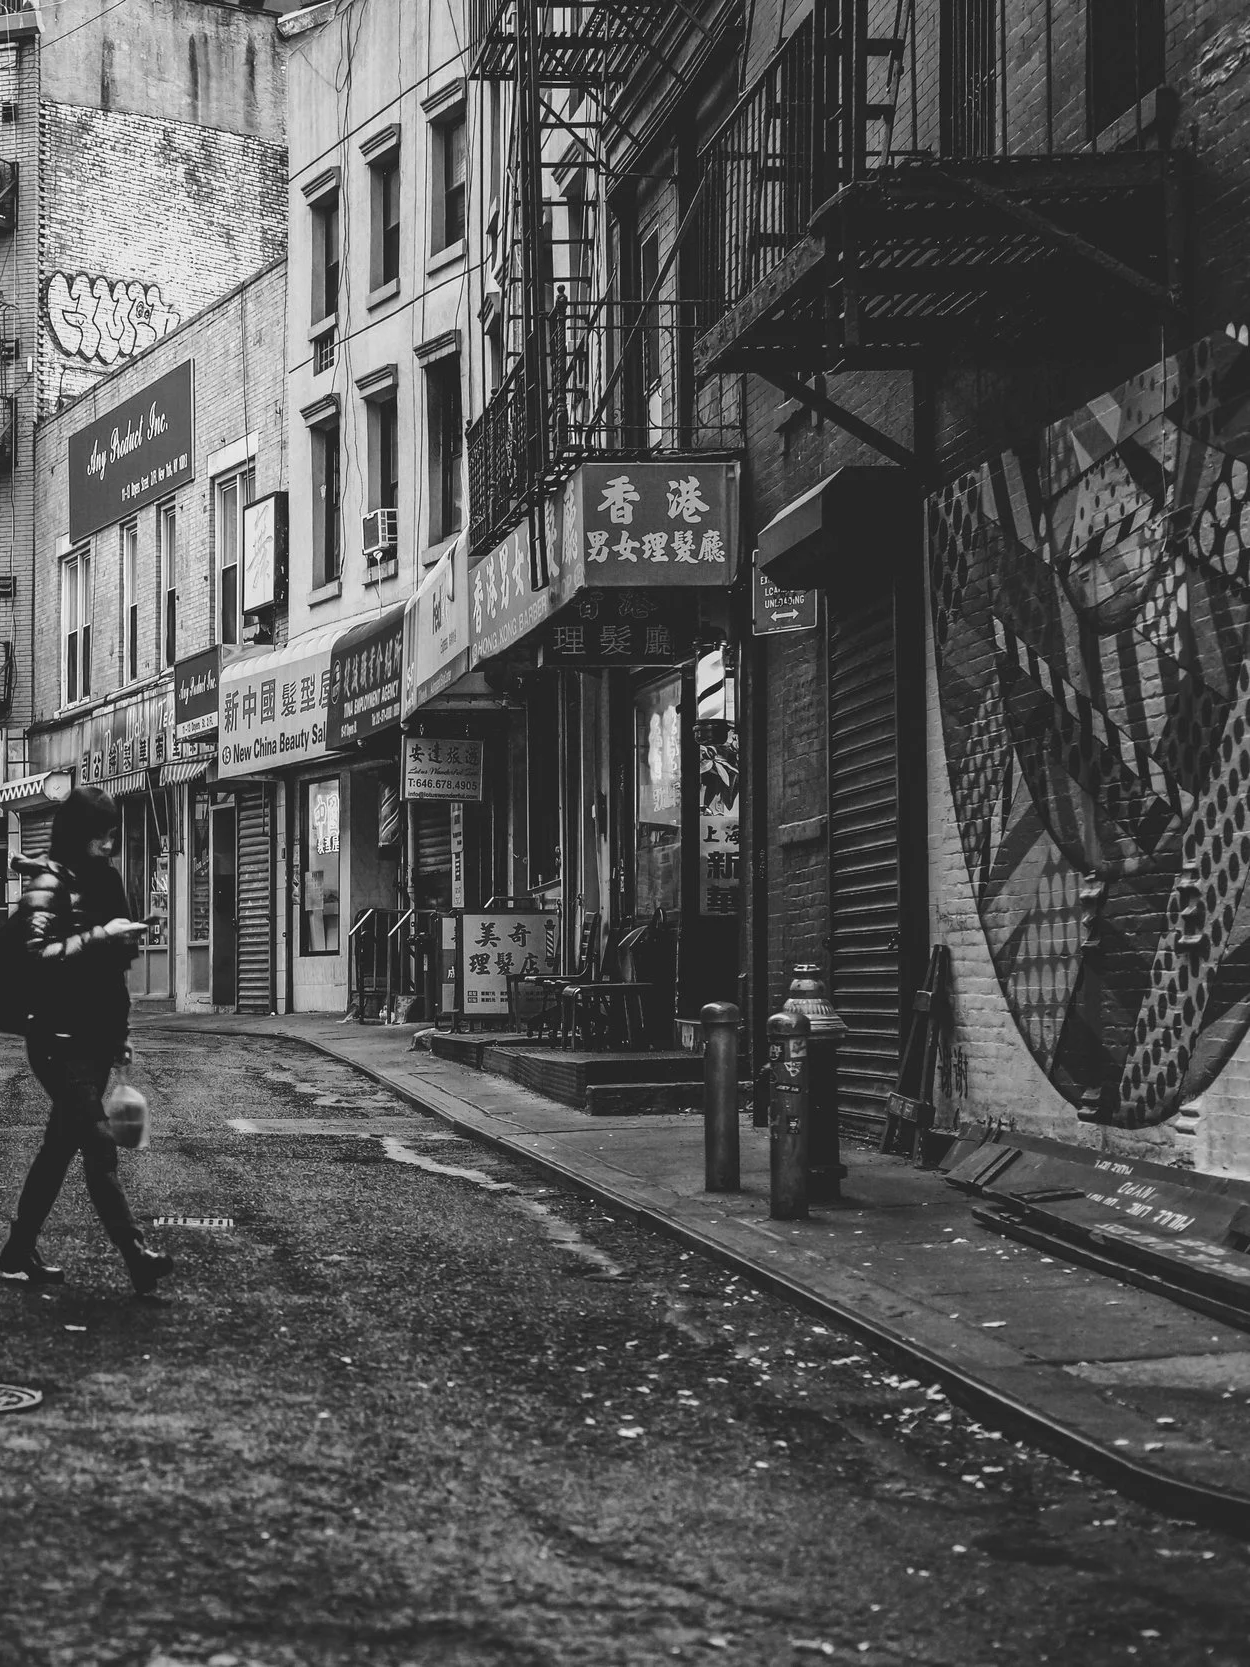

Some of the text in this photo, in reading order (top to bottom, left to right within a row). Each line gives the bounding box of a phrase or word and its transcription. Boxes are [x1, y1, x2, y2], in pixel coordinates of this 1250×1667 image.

[87, 401, 169, 480] Any Product Inc.
[597, 475, 710, 525] 香港
[587, 529, 726, 564] 男女理髮廳
[478, 631, 499, 656] HONG
[518, 596, 548, 631] BARBER
[553, 625, 671, 656] 理髮廳
[234, 743, 252, 763] New
[254, 735, 278, 759] China
[280, 729, 310, 757] Beauty
[475, 922, 532, 948] 美奇
[1117, 1182, 1157, 1199] NYPD
